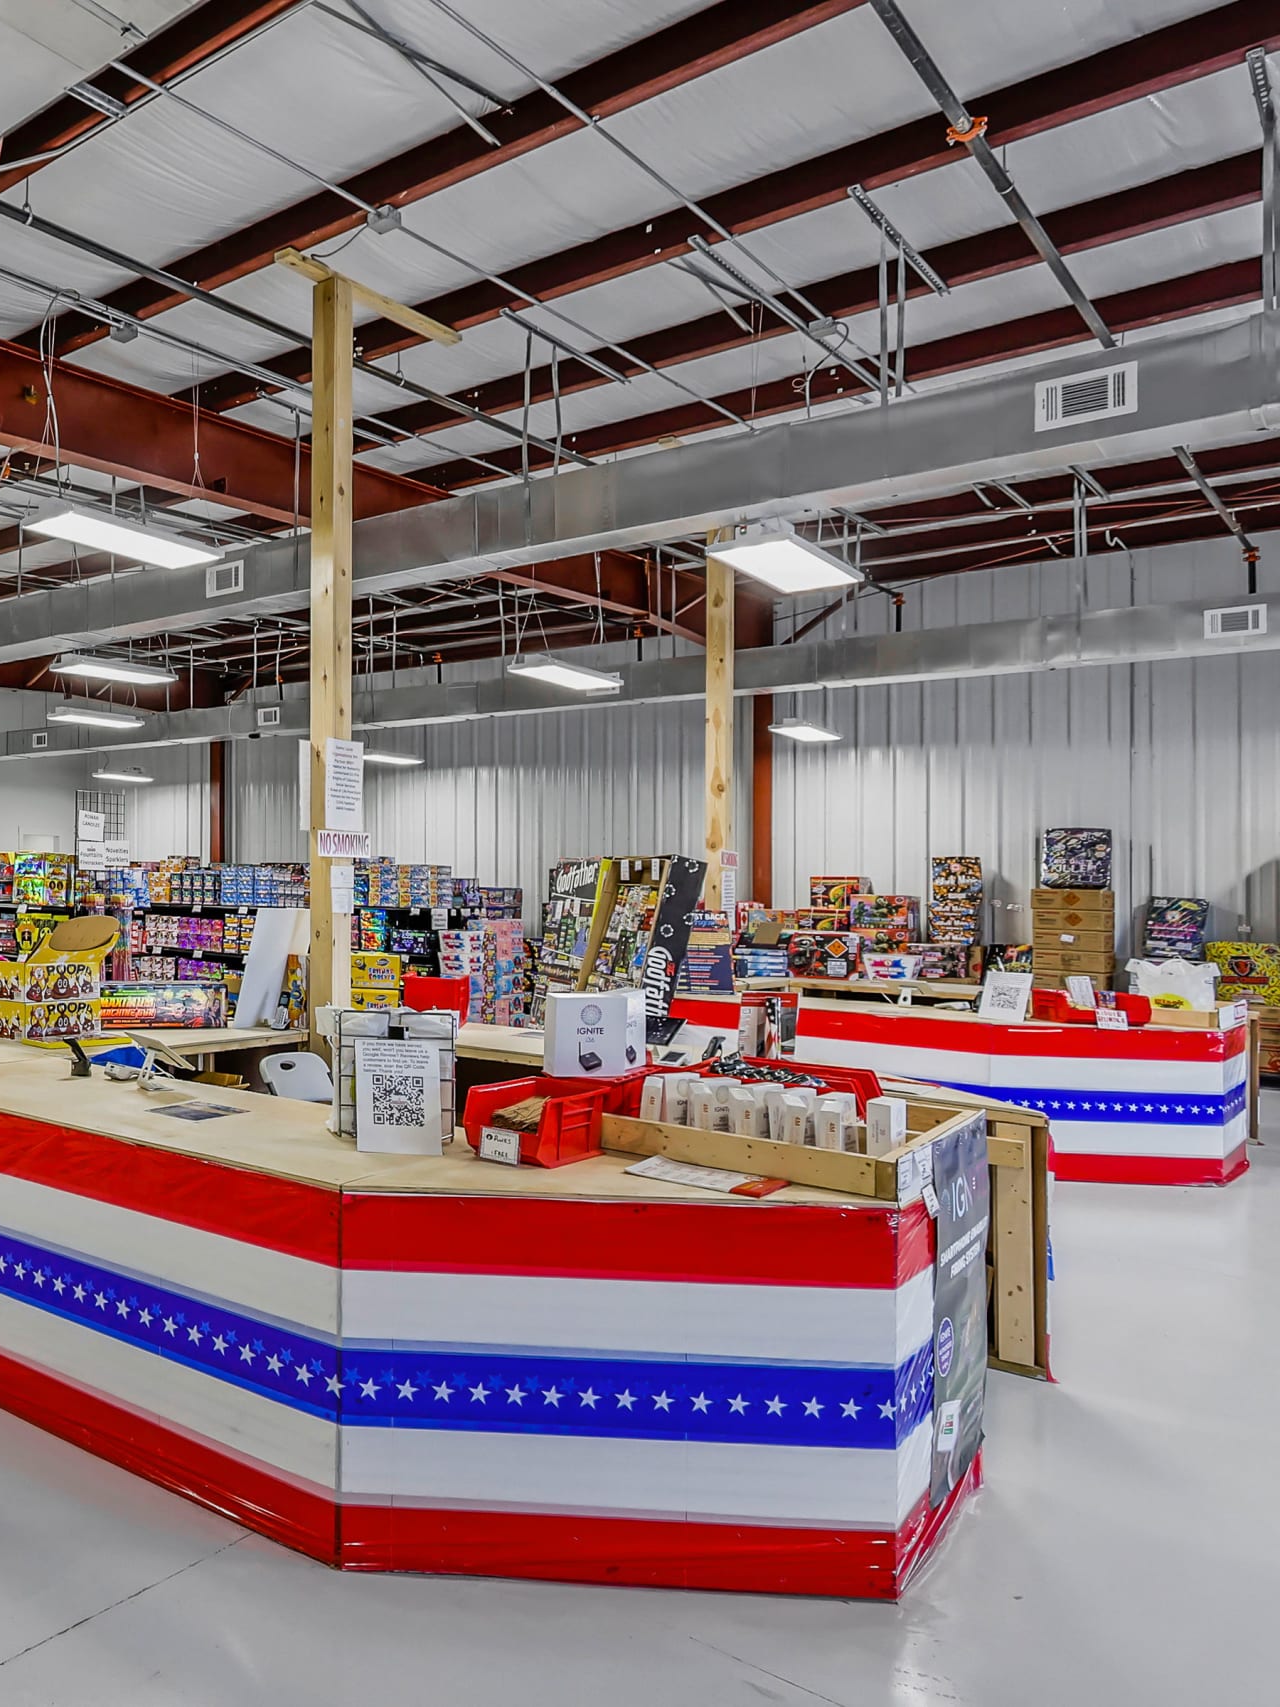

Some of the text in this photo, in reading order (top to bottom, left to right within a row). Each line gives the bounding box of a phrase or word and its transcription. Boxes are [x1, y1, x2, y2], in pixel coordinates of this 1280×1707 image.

[320, 832, 369, 855] NO SMOKING
[557, 862, 599, 892] Godfather
